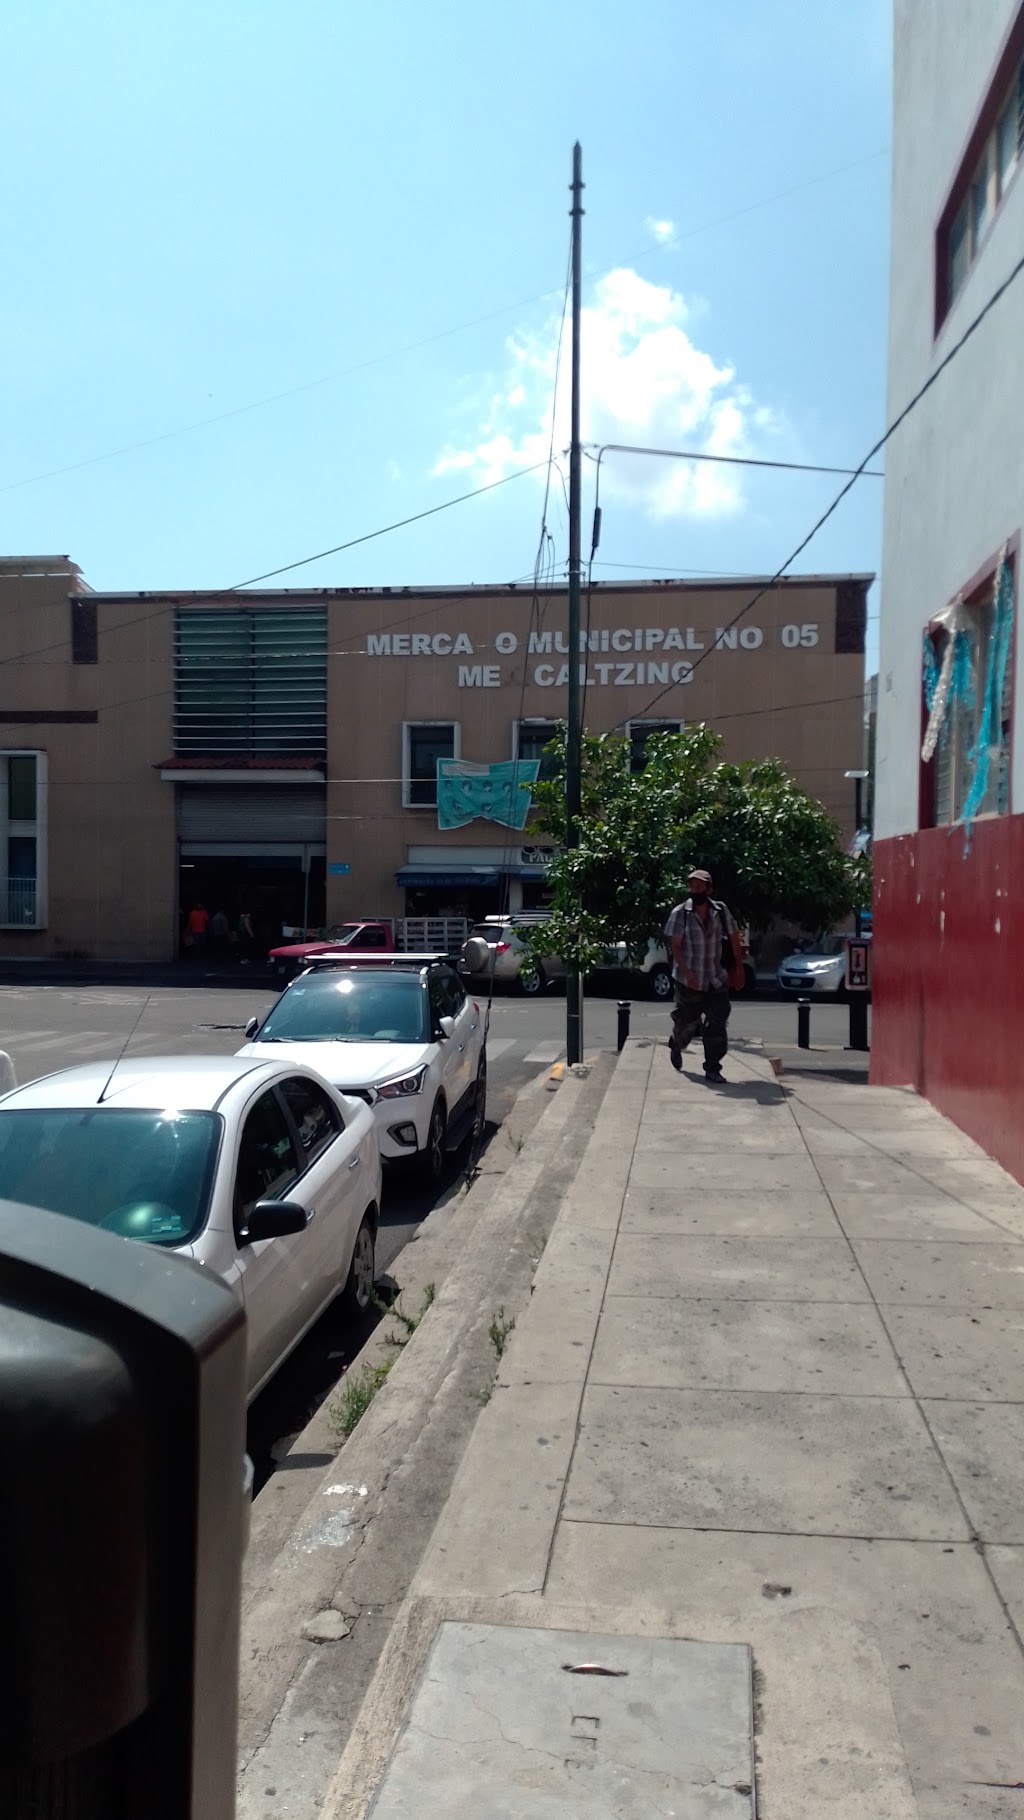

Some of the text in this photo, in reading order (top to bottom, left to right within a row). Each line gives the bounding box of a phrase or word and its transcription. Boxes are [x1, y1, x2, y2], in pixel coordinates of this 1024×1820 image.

[527, 626, 705, 654] MUNICIPAL
[716, 626, 764, 651] NO
[781, 623, 819, 648] 05
